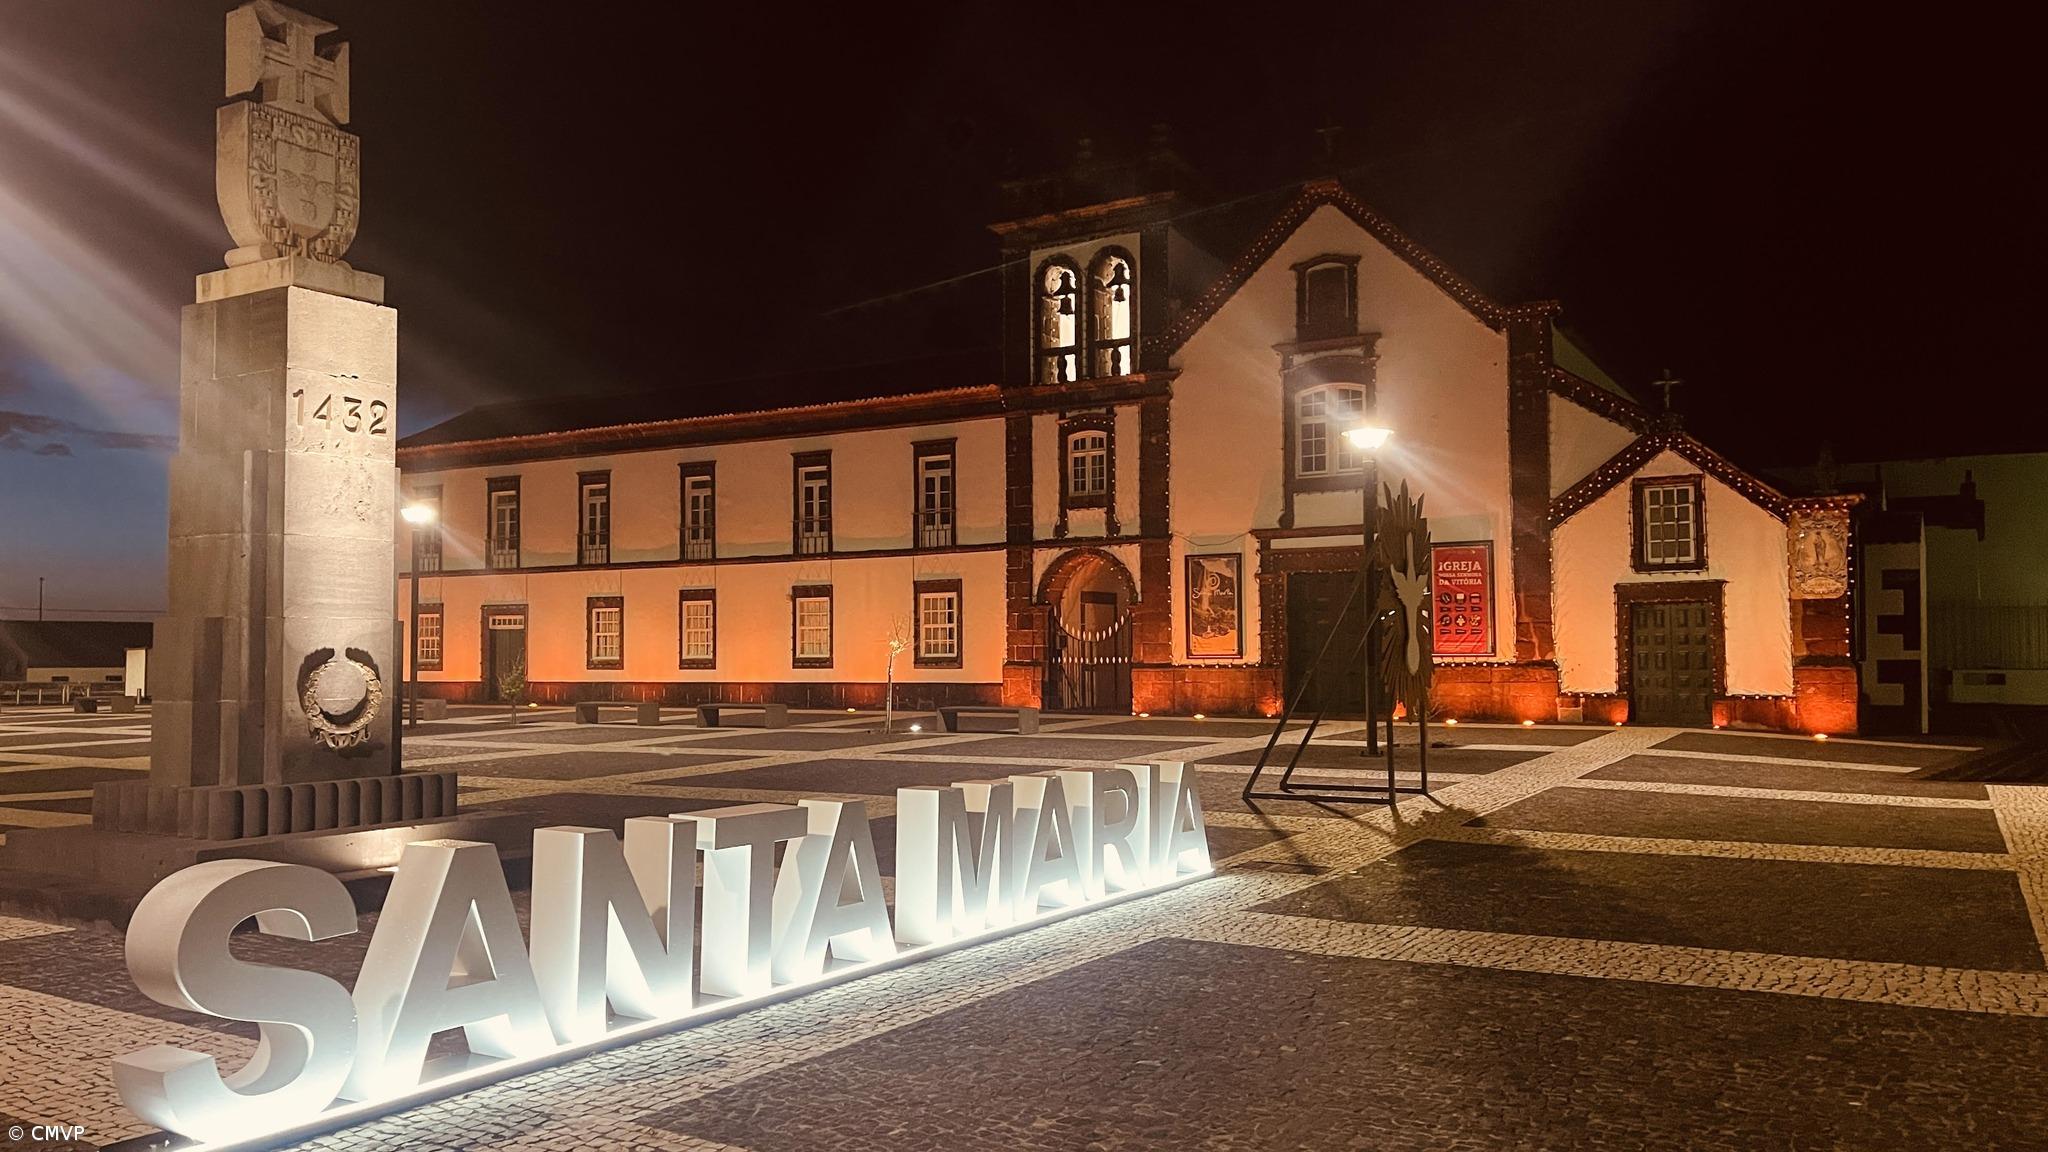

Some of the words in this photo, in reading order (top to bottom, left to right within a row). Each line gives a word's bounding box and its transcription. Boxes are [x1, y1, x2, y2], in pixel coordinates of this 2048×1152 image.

[292, 388, 388, 435] 1432
[1438, 561, 1482, 572] IGREJA
[112, 799, 899, 1145] SANTA
[895, 761, 1214, 947] MARIA
